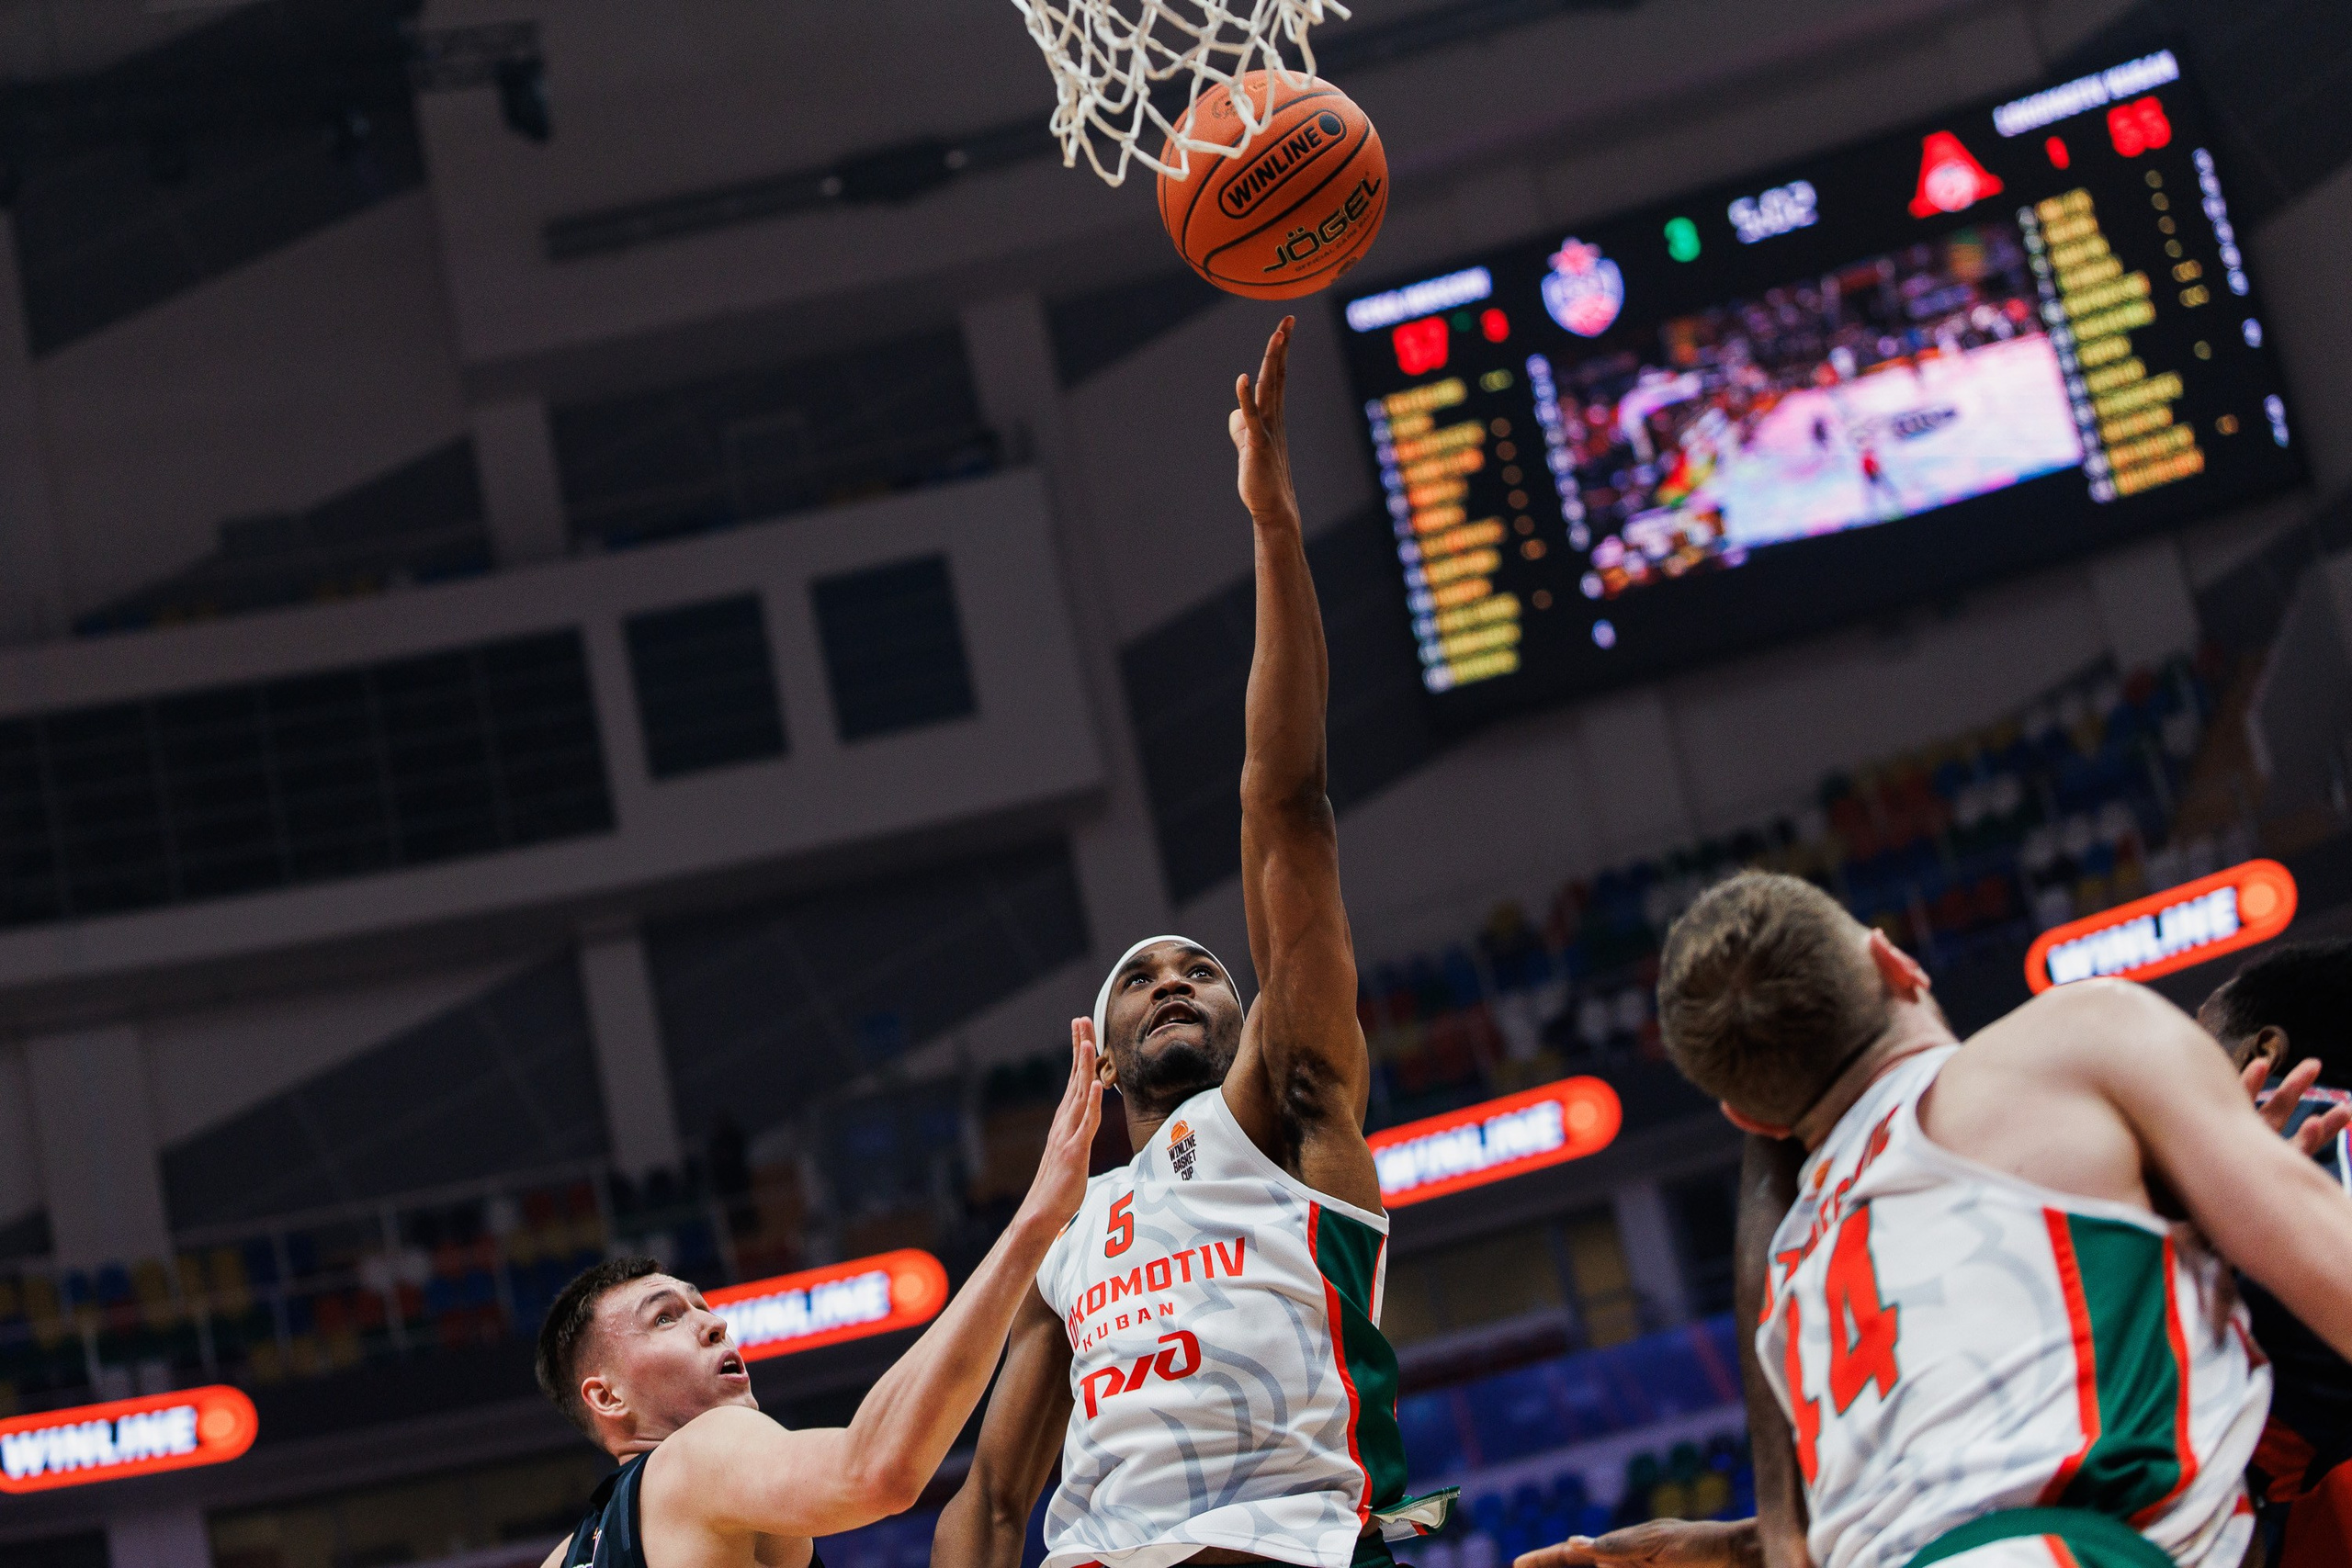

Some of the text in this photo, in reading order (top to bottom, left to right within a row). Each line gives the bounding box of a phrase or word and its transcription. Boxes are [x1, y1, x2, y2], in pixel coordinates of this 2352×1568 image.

[1227, 126, 1323, 210] WINLINE
[1263, 176, 1382, 274] JÖGEL
[2046, 886, 2239, 985] WINLINE
[1169, 1134, 1196, 1161] WINLINE
[1173, 1149, 1196, 1174] BASKET
[1181, 1166, 1193, 1181] CUP
[1104, 1190, 1134, 1258] 5
[1069, 1237, 1246, 1350] OKOMOTIV
[1082, 1302, 1174, 1353] KUBAN
[0, 1404, 198, 1481] WINLINE
